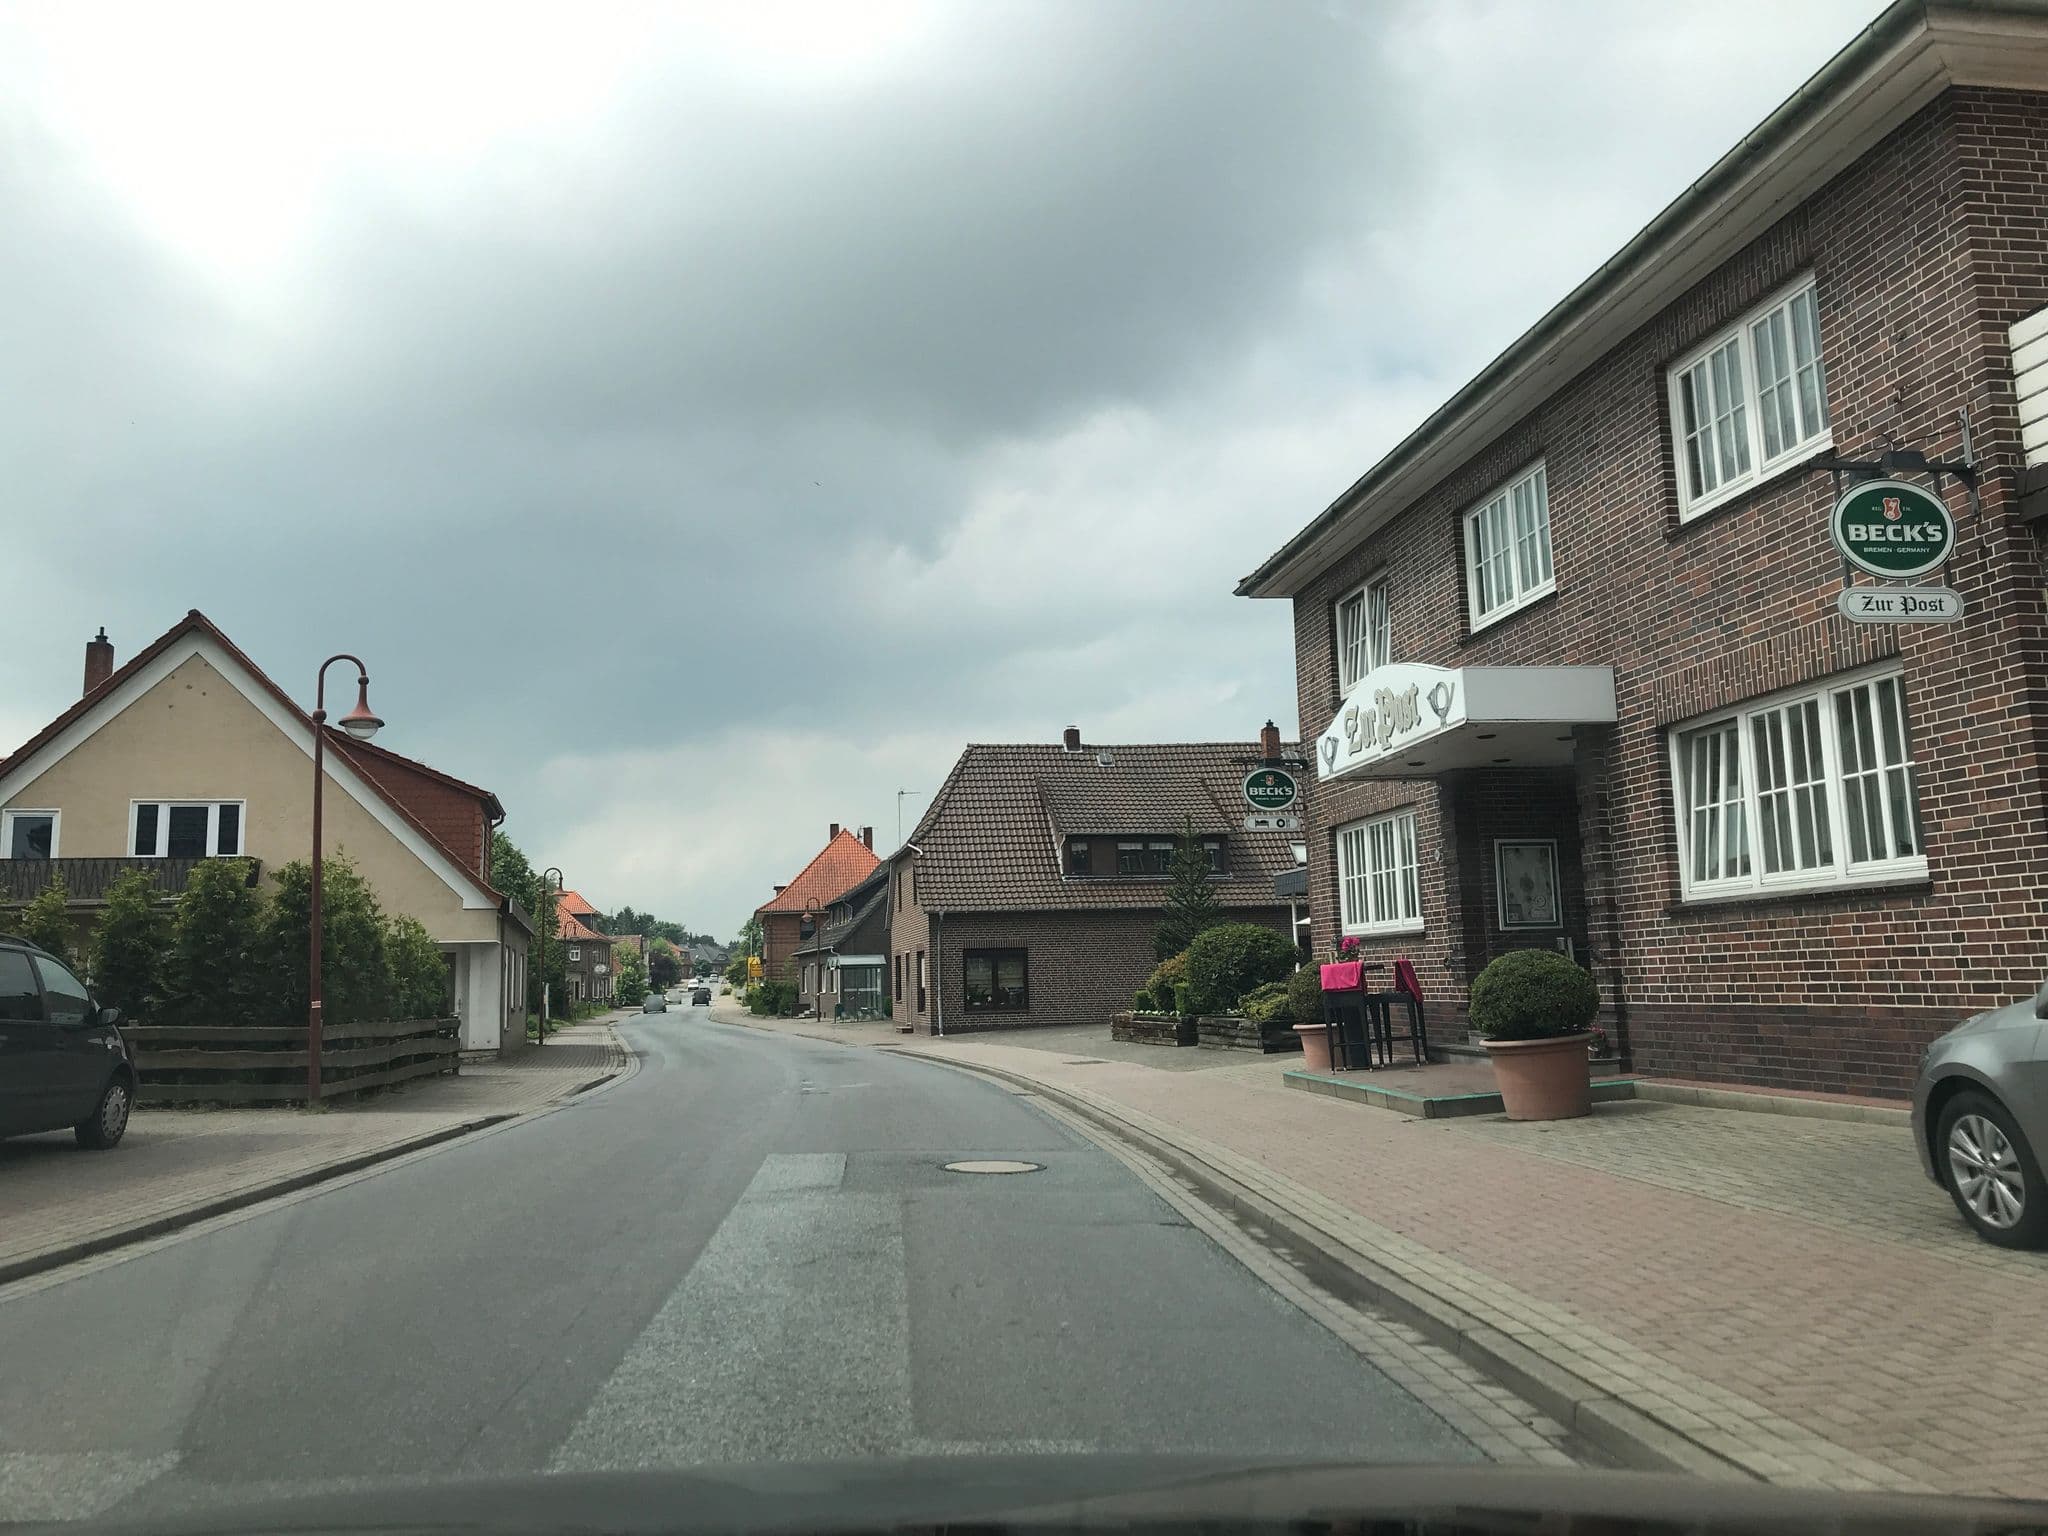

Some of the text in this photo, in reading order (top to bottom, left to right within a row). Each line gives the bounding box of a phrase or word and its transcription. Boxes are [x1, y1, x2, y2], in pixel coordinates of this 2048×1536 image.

[1848, 522, 1943, 542] BECK'S
[1861, 595, 1945, 615] Zur Post
[1344, 682, 1422, 757] Zur Post
[1249, 786, 1293, 796] BECK'S
